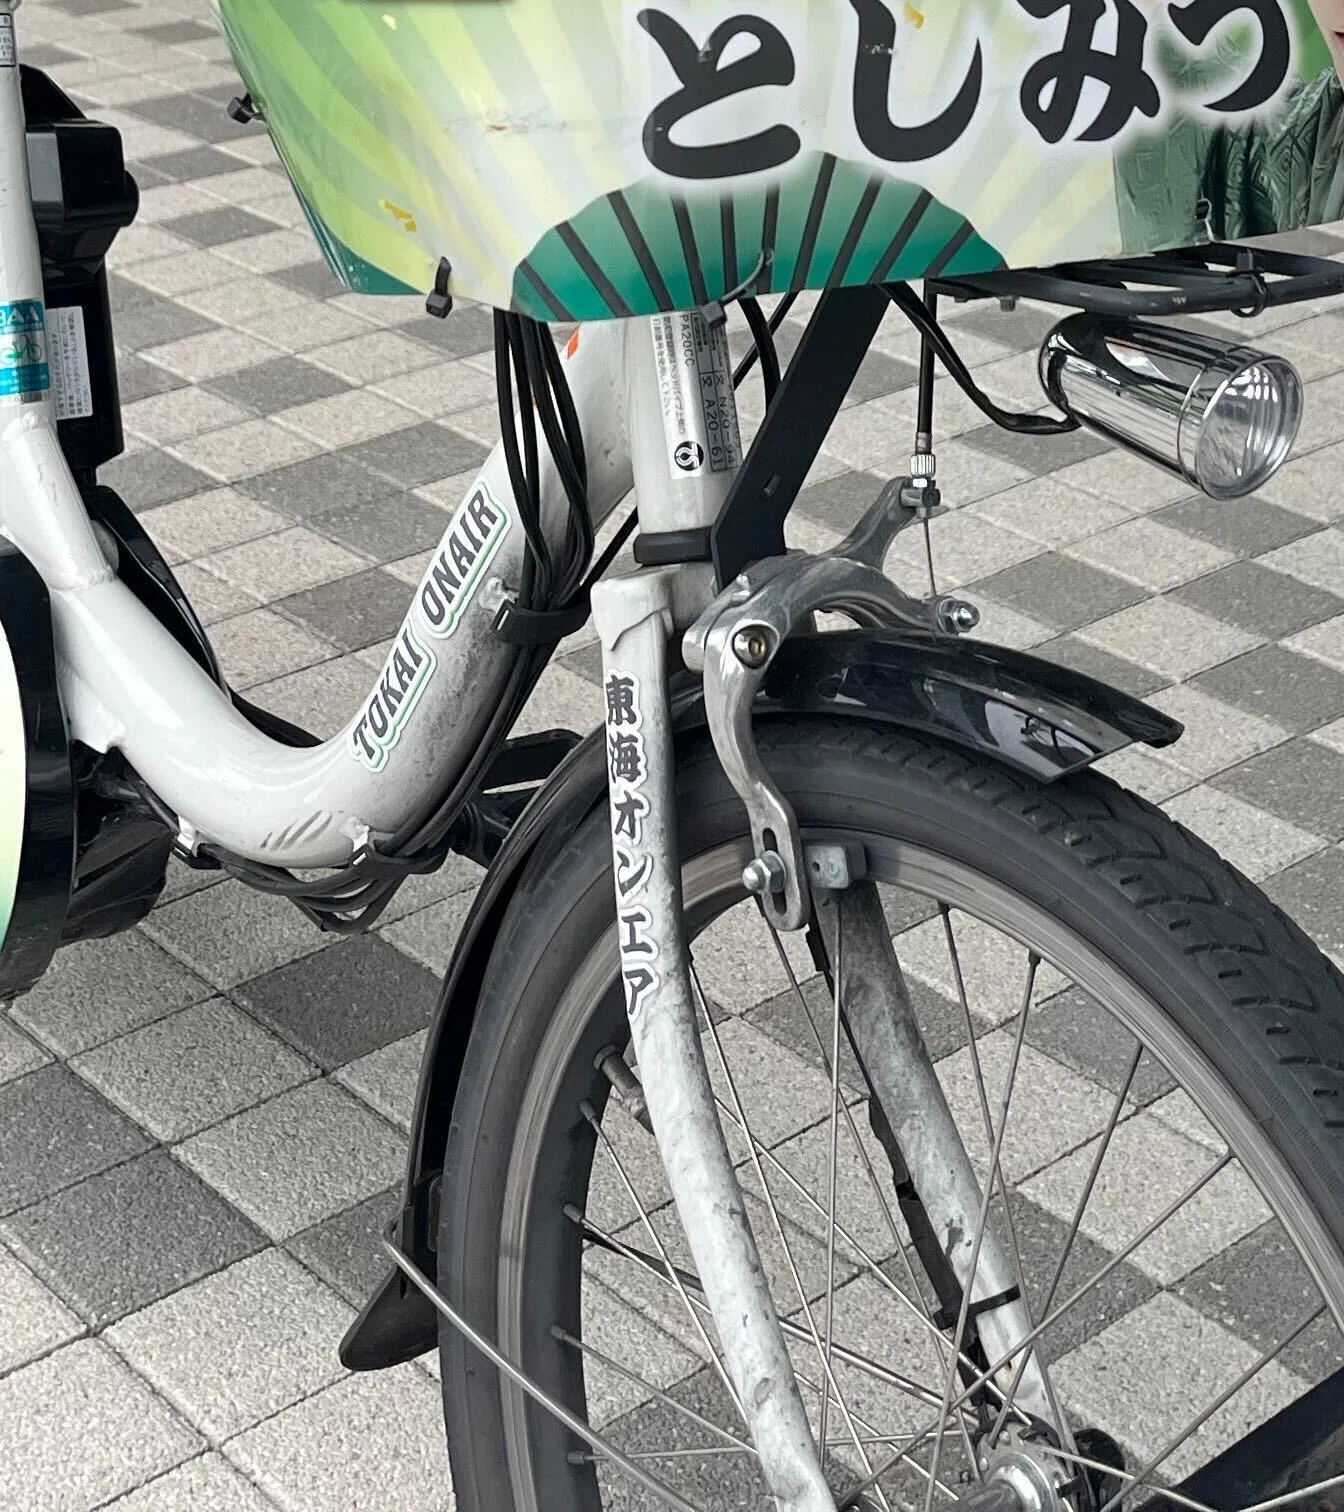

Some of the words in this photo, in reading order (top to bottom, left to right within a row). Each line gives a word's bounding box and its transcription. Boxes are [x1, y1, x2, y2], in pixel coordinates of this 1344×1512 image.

[352, 628, 425, 760] TOKAI
[421, 491, 498, 624] ONAIR
[605, 674, 659, 1018] 東海オンエア
